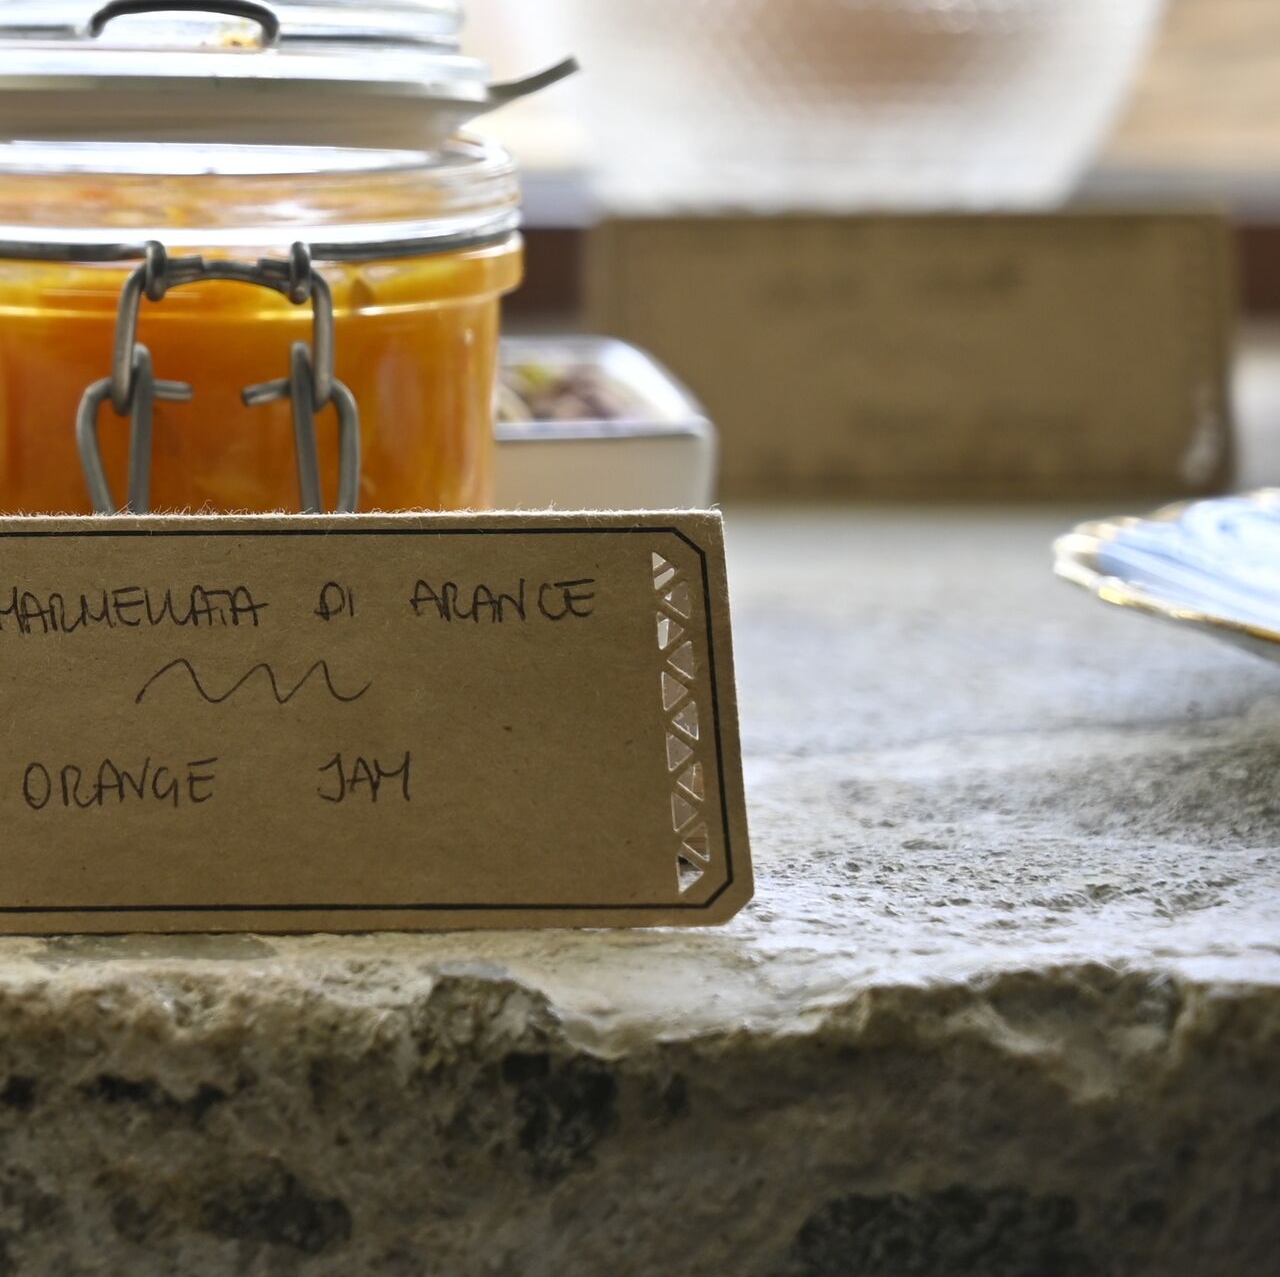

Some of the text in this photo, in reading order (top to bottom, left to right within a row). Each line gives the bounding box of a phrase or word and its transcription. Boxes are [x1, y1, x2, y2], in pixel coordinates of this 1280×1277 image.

[314, 581, 354, 622] DI
[409, 578, 594, 623] ARANCE
[22, 751, 411, 810] ORANGE JAM
